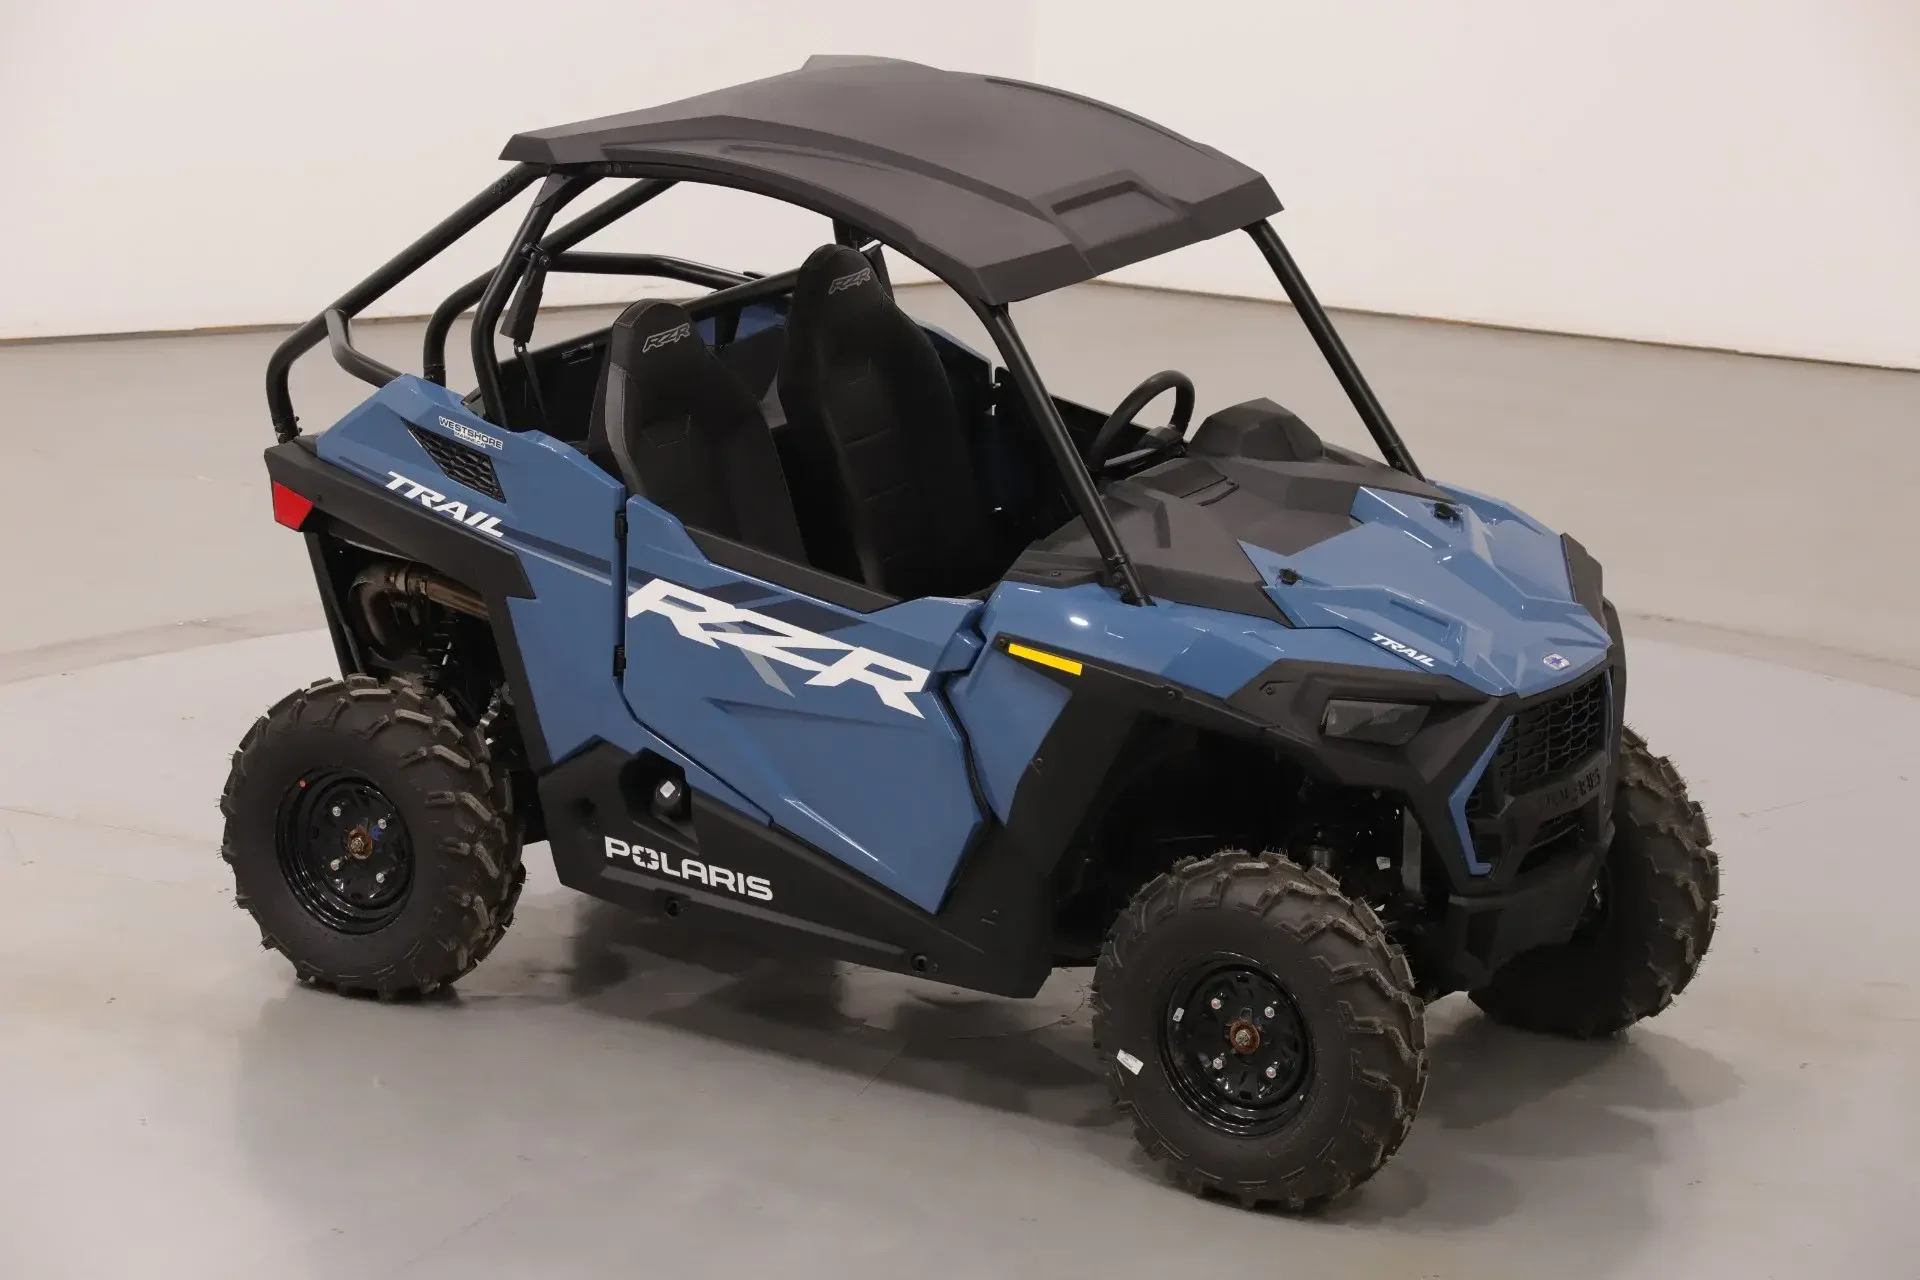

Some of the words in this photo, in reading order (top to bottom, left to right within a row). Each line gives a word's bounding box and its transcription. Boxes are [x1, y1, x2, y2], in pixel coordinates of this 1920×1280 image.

[829, 267, 871, 295] RZR
[643, 323, 690, 353] RZR
[440, 417, 502, 449] WESTSHORE
[385, 470, 504, 538] TRAIL
[628, 578, 931, 720] RZR
[1370, 632, 1435, 667] TRAIL
[604, 835, 774, 901] POLARIS
